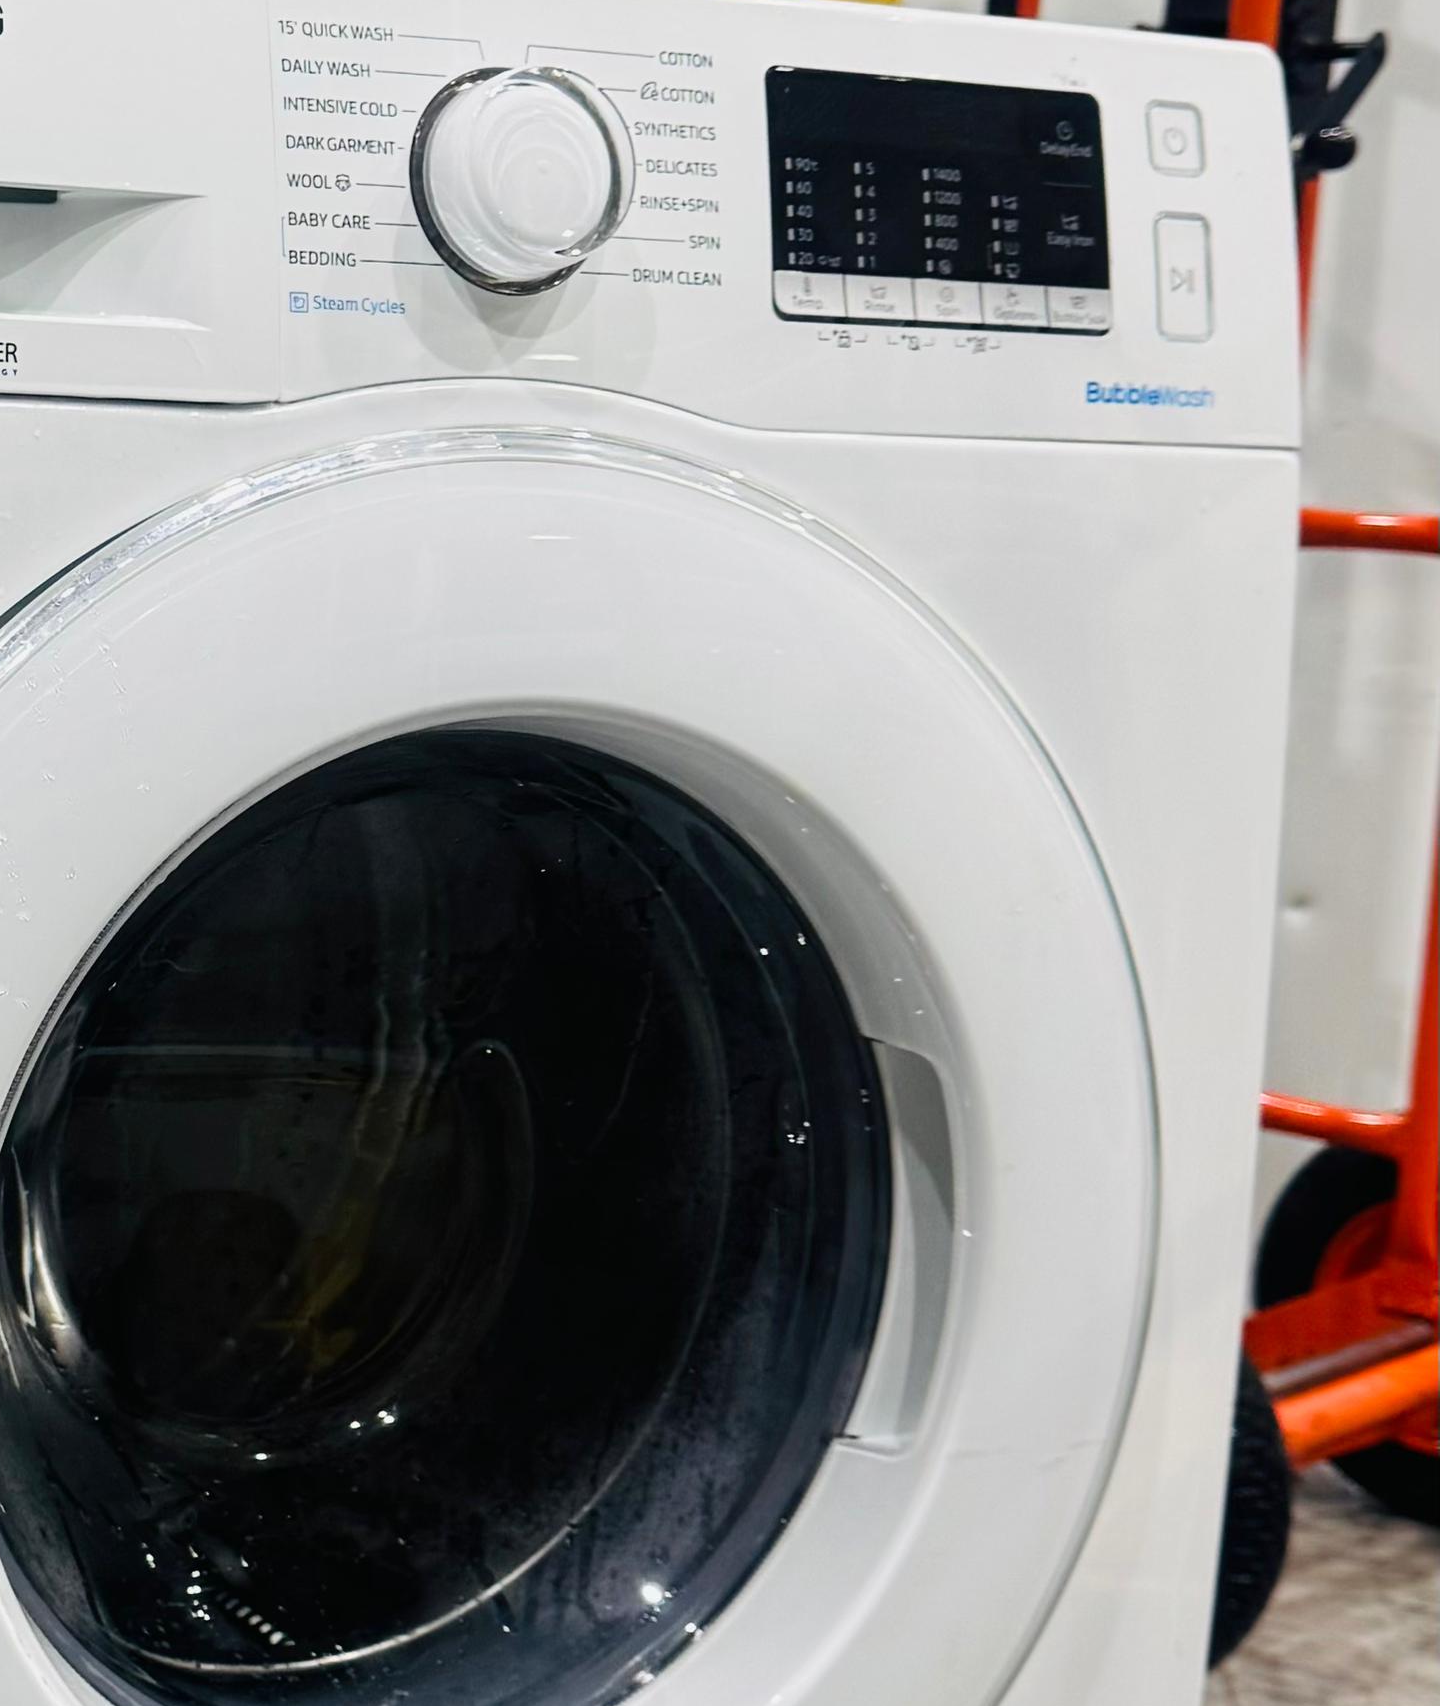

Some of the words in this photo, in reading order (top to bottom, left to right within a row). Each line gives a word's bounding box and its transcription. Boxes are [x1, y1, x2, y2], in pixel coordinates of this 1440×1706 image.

[302, 21, 350, 40] QUICK
[351, 24, 394, 42] WASH
[659, 51, 713, 68] COTTON
[281, 59, 324, 76] DAILY
[326, 61, 371, 78] WASH
[661, 87, 715, 104] COTTON
[283, 97, 357, 116] INTENSIVE
[359, 100, 398, 118] COLD
[634, 122, 717, 141] SYNTHETICS
[286, 135, 325, 151] DARK
[326, 137, 396, 156] GARMENT
[645, 159, 718, 177] DELICATES
[865, 161, 876, 176] 5
[933, 168, 962, 182] 1400
[287, 173, 332, 190] WOOL
[796, 181, 813, 195] 60
[865, 185, 876, 198] 4
[640, 196, 720, 213] RINSE+SPIN
[796, 205, 813, 218] 40
[288, 211, 327, 229] BABY
[329, 214, 371, 230] CARE
[867, 208, 877, 222] 3
[688, 234, 721, 250] SPIN
[798, 228, 814, 242] 30
[867, 231, 878, 245] 2
[935, 237, 959, 251] 400
[289, 249, 357, 268] BEDDING
[798, 252, 815, 266] 20
[869, 255, 877, 268] 1
[632, 269, 672, 286] DRUM
[676, 271, 722, 288] CLEAN
[312, 295, 358, 313] Steam
[361, 297, 406, 315] Cycles
[1086, 380, 1216, 407] BubbleWash
